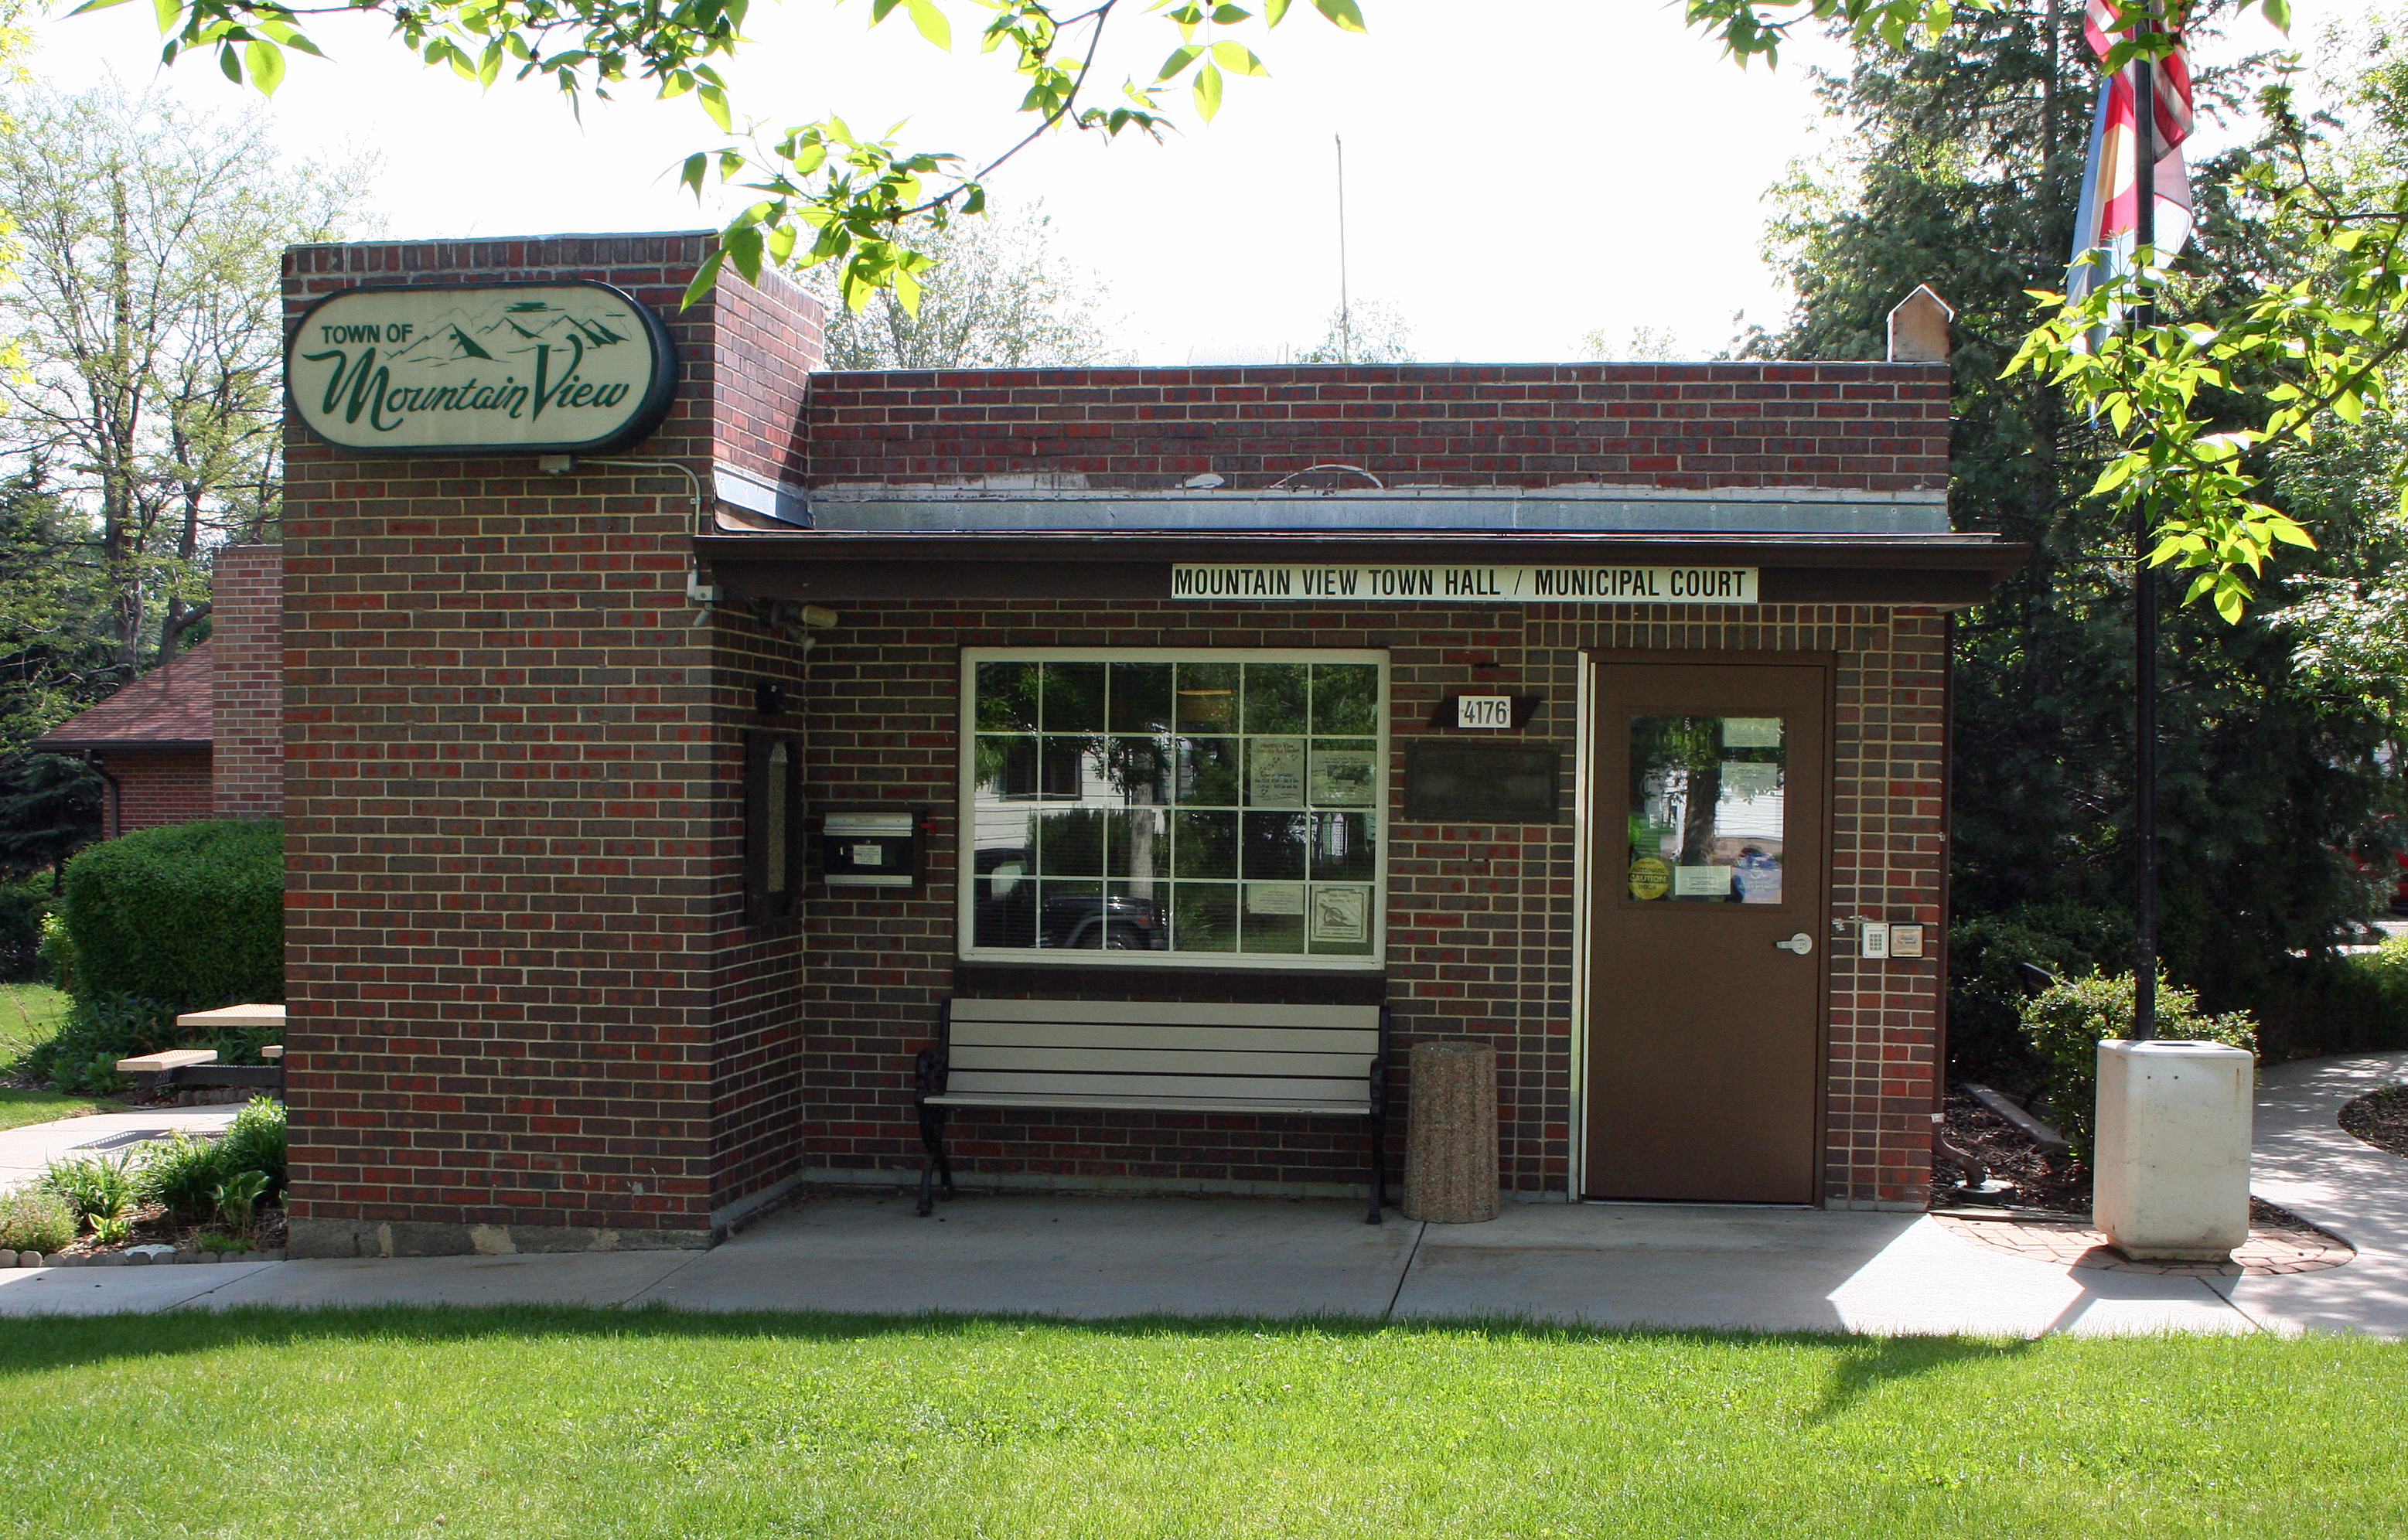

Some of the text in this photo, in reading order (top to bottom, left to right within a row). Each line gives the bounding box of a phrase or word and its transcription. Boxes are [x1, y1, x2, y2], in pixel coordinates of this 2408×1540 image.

[321, 323, 414, 345] TOWN OF
[302, 334, 631, 432] Mountain View
[1174, 568, 1291, 595] MOUNTAIN
[1302, 568, 1359, 595] VIEW
[1368, 568, 1434, 596] TOWN
[1444, 569, 1501, 596] HALL
[1534, 569, 1660, 597] MUNICIPAL
[1670, 570, 1747, 597] COURT
[1464, 700, 1507, 724] 4176
[1629, 874, 1666, 883] CAUTION
